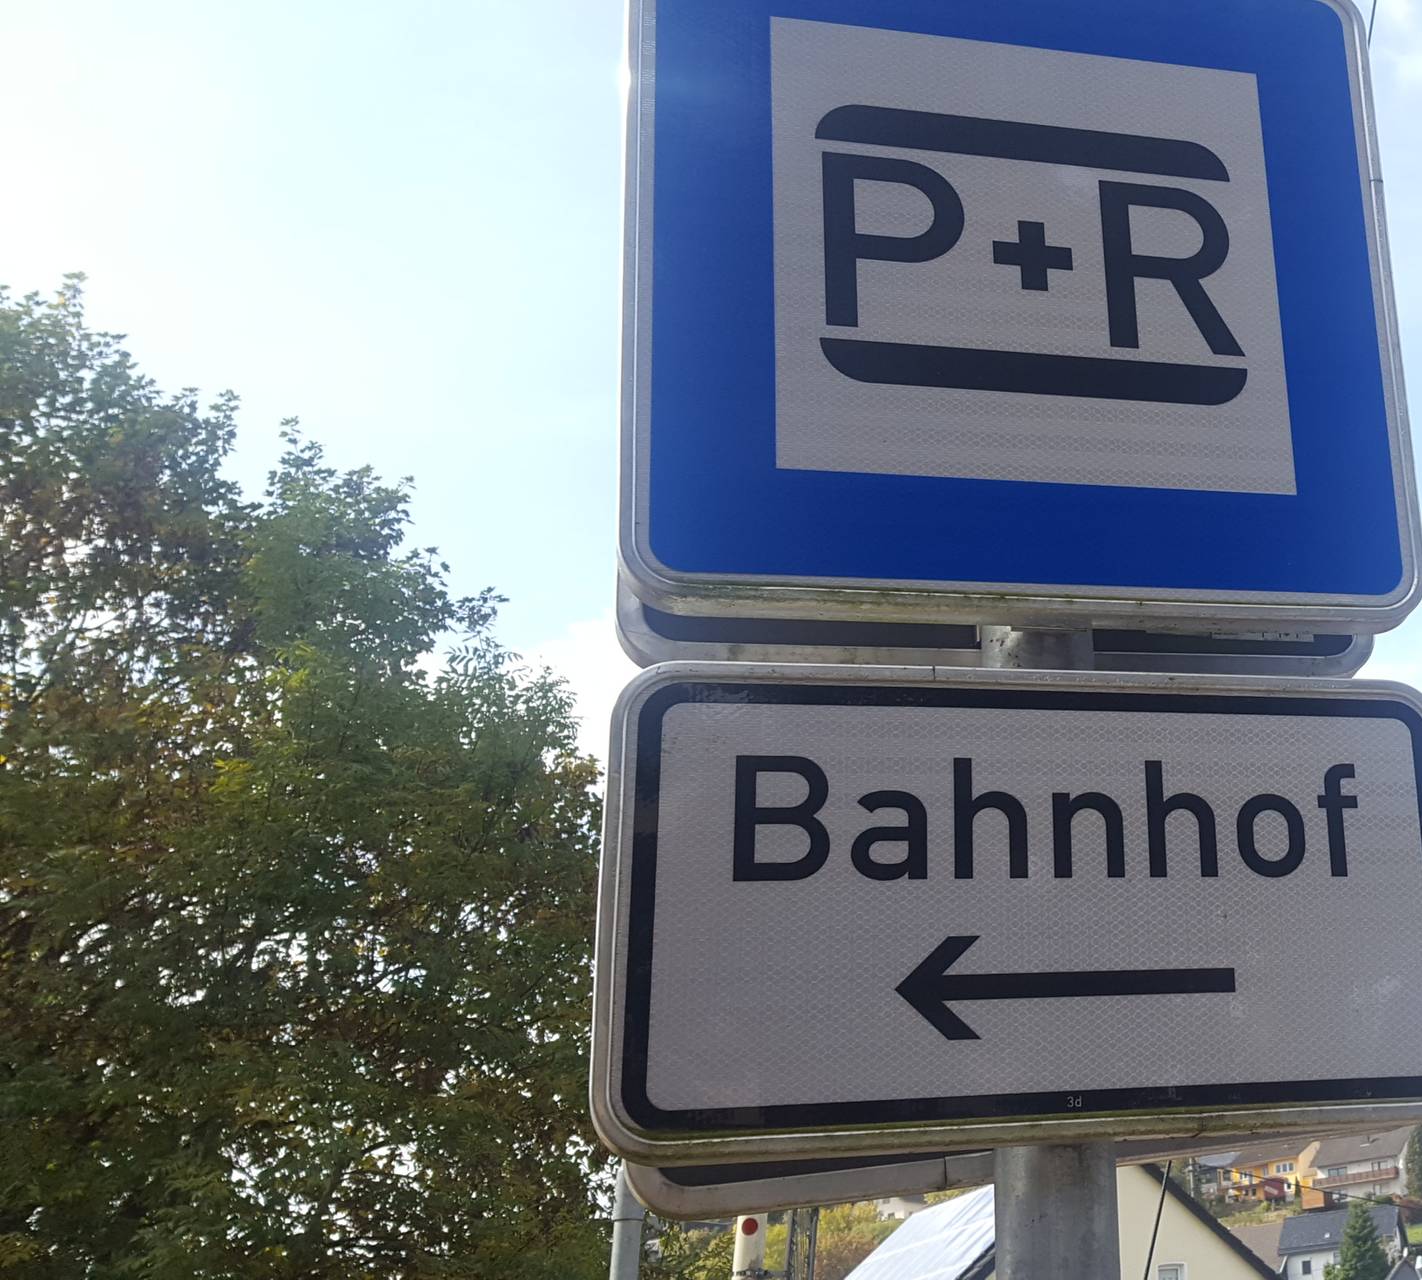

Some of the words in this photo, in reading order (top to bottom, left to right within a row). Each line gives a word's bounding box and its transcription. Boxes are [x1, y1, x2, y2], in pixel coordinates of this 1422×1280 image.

[822, 151, 1246, 358] P+R
[732, 755, 1359, 882] Bahnhof
[1066, 1095, 1082, 1108] 3d
